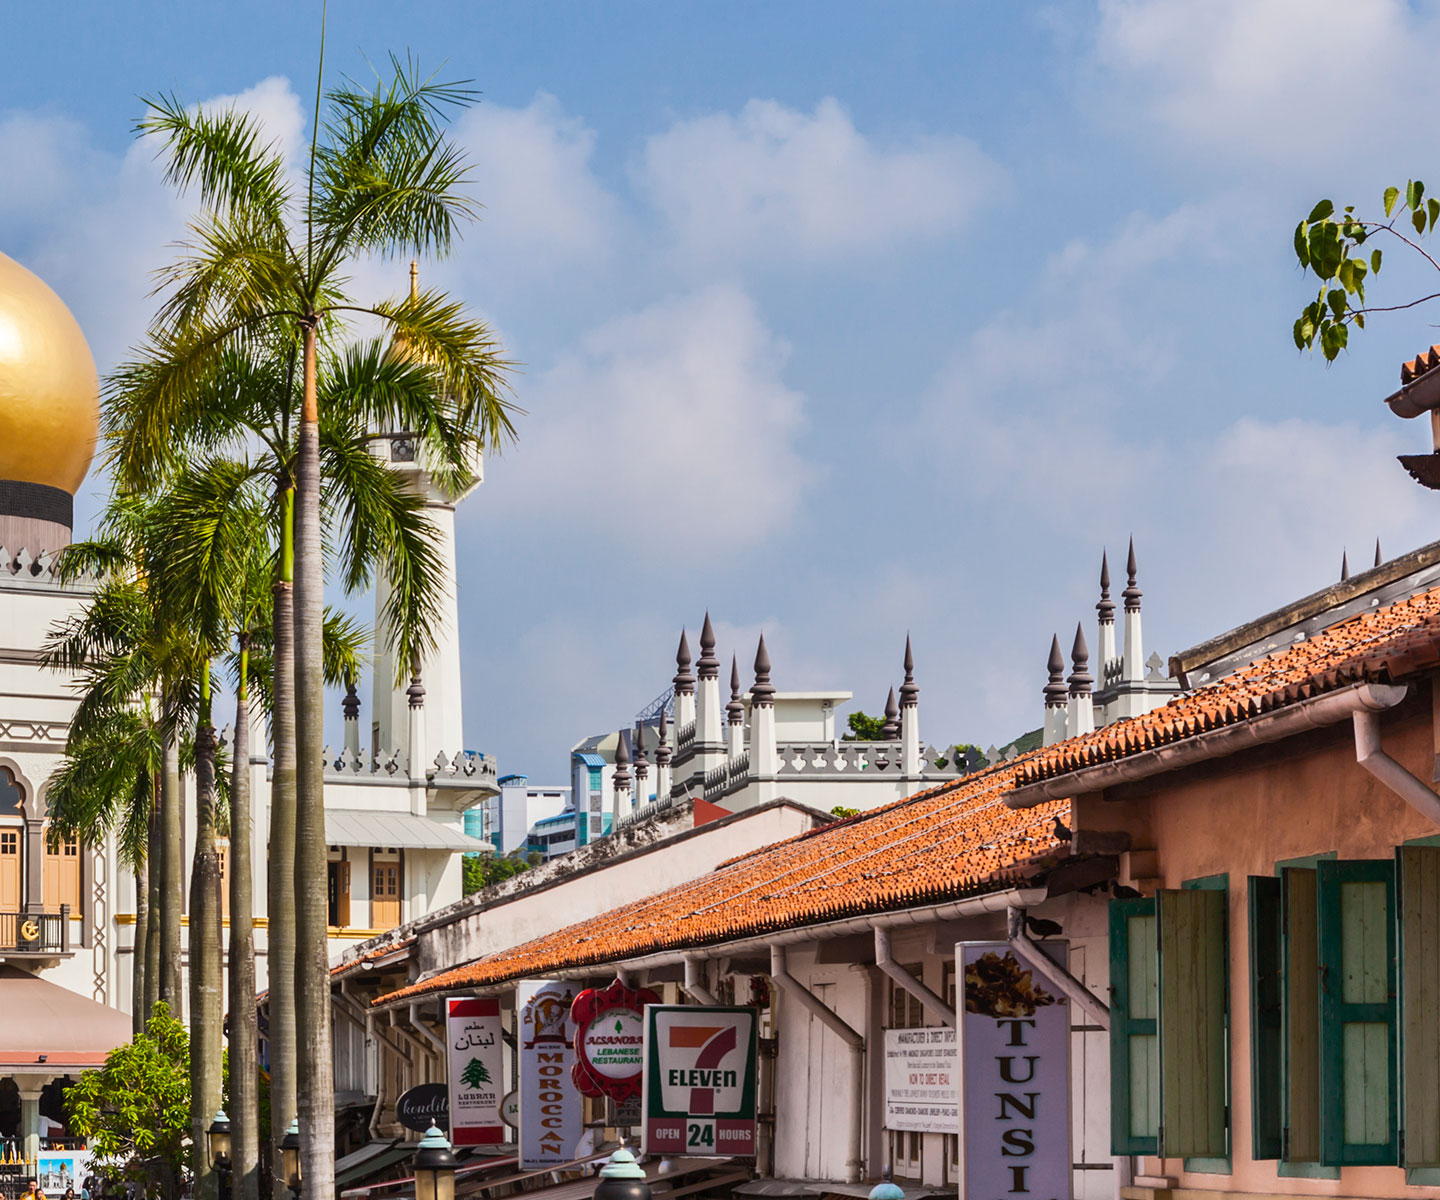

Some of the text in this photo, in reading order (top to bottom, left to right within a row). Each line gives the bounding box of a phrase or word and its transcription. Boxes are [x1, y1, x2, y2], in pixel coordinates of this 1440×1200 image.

[454, 1032, 495, 1051] لبنان
[586, 1035, 643, 1045] ALSANOBA
[669, 1026, 736, 1114] 7
[537, 1053, 564, 1155] MOROCCAN
[655, 1124, 752, 1147] OPEN 24 HOURS
